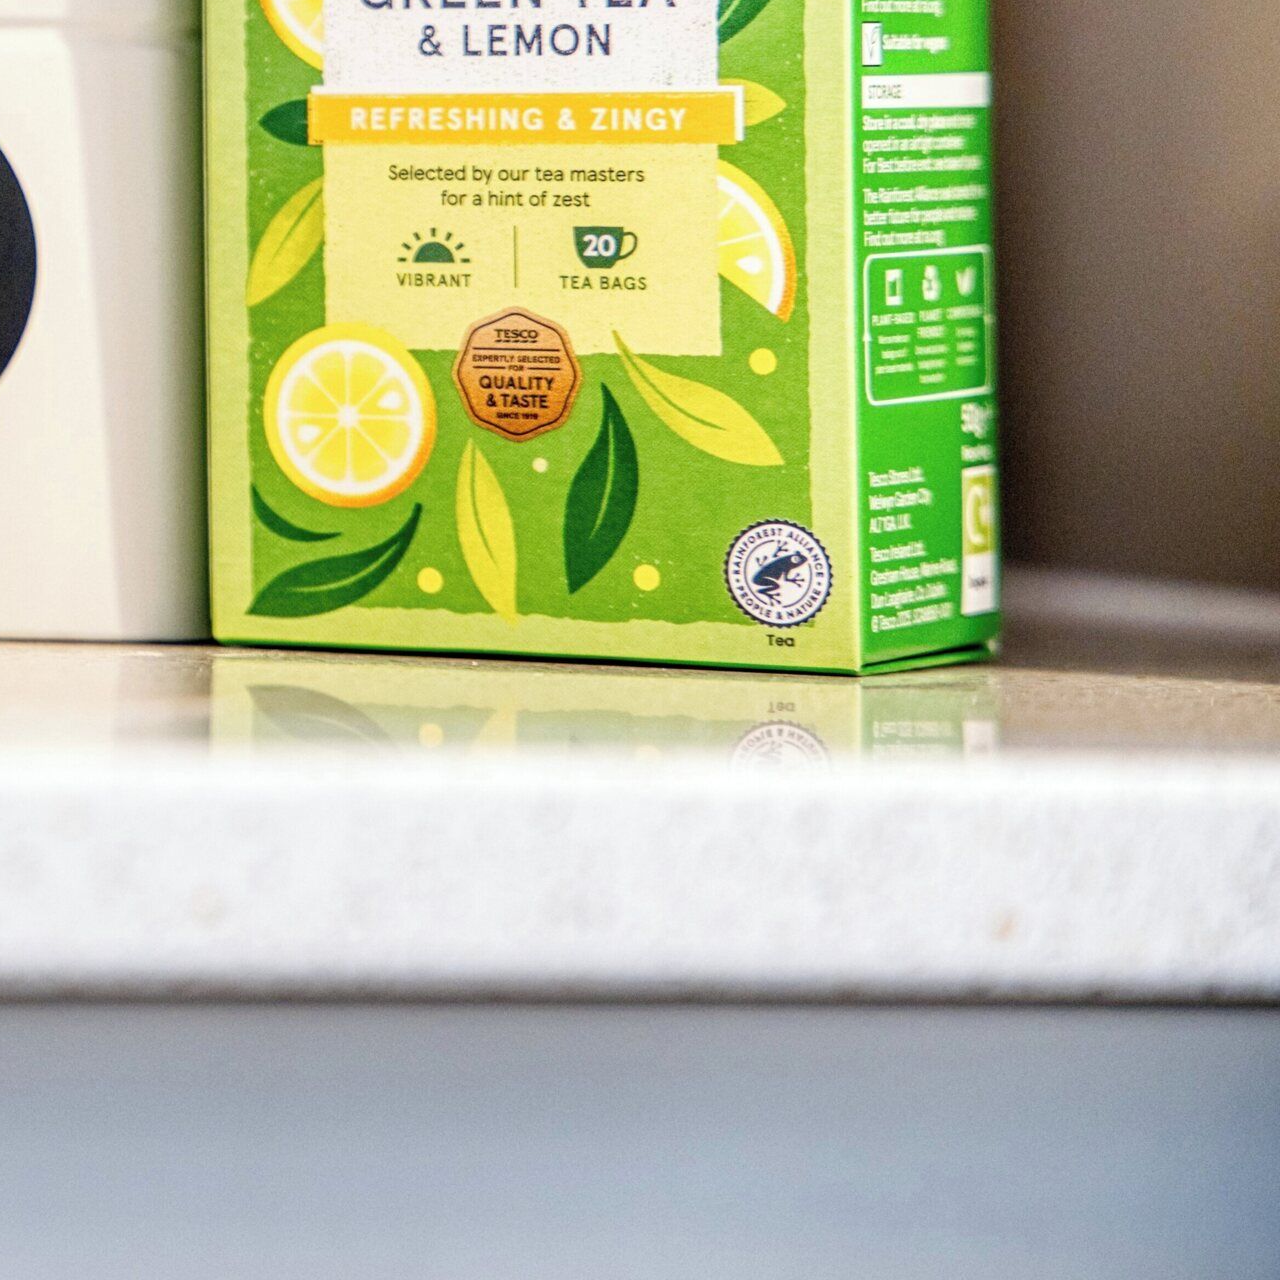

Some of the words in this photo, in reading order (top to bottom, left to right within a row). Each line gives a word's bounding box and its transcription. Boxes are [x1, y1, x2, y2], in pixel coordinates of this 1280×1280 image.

[419, 24, 442, 57] &
[463, 23, 612, 57] LEMON
[351, 107, 545, 132] REFRESHING
[558, 107, 576, 131] &
[590, 107, 687, 132] ZINGY
[388, 165, 466, 182] Selected
[472, 165, 493, 187] by
[497, 168, 529, 182] our
[534, 167, 564, 182] tea
[570, 167, 645, 183] masters
[441, 190, 467, 207] for
[471, 194, 484, 207] a
[488, 190, 523, 207] hint
[529, 190, 547, 207] of
[552, 192, 590, 208] zest
[583, 234, 616, 257] 20
[397, 273, 471, 288] VIBRANT
[559, 276, 593, 290] TEA
[599, 276, 647, 291] BAGS
[494, 329, 539, 339] TESCO
[517, 355, 560, 365] SELECTED
[479, 375, 554, 392] QUALITY
[486, 394, 497, 407] &
[501, 394, 549, 408] TASTE
[732, 528, 783, 575] RAINFOREST
[787, 531, 825, 577] ALLIANCE
[737, 586, 772, 618] PEOPLE
[776, 612, 783, 620] &
[787, 589, 821, 619] NATURE
[766, 634, 795, 647] Tea
